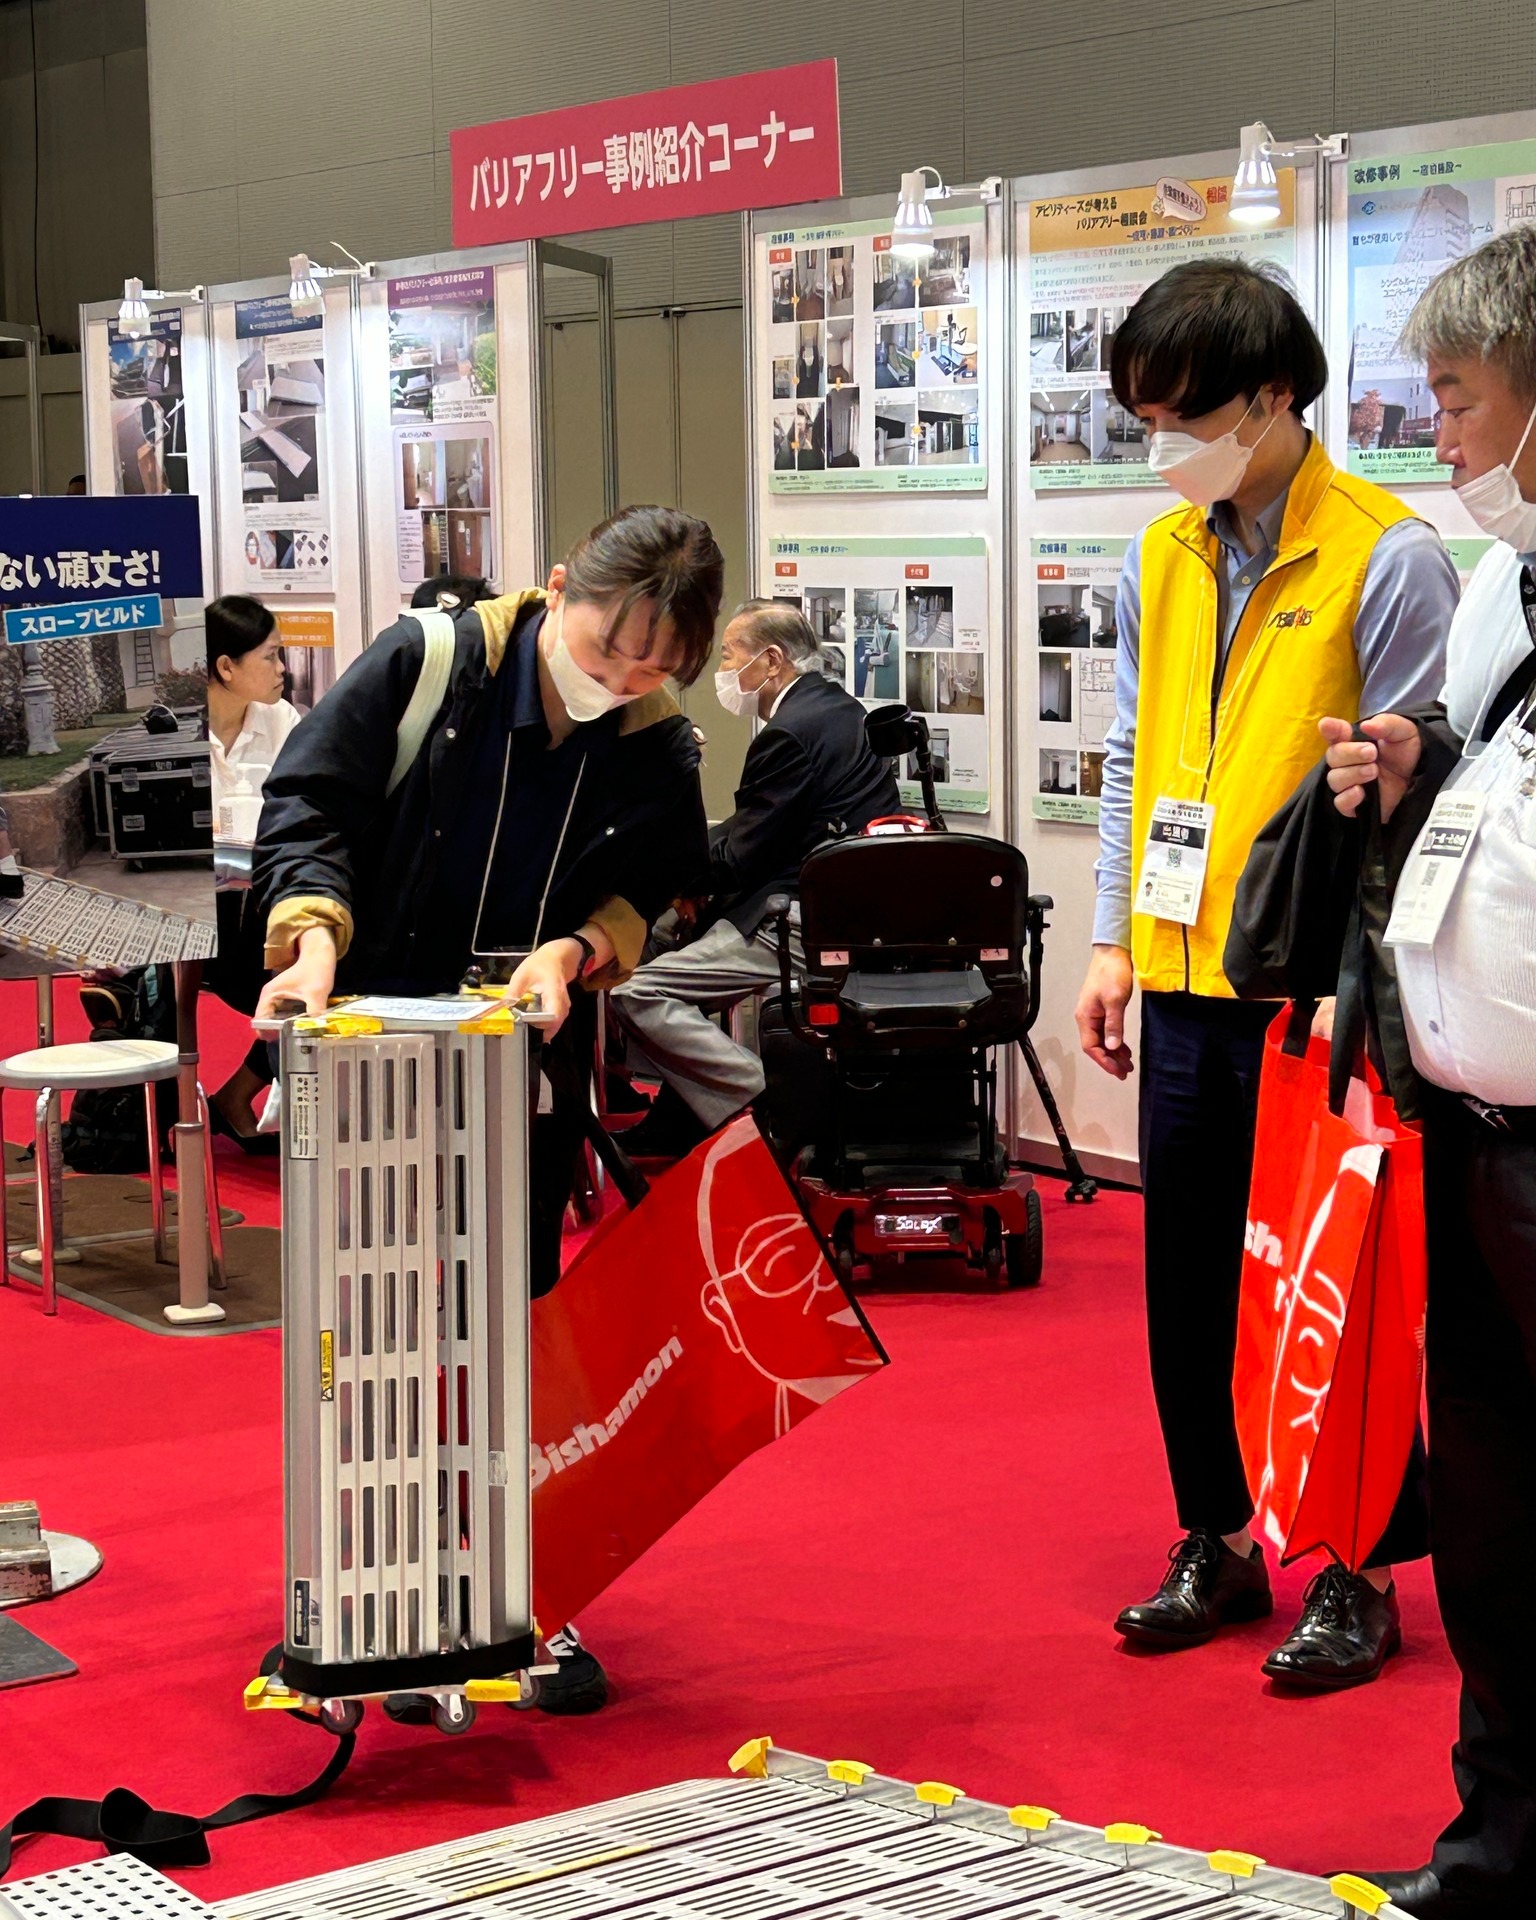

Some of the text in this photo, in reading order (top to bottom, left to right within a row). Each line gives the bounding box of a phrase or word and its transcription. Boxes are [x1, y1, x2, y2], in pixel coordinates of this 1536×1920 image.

[470, 110, 815, 211] バリアフリー事例紹介コーナー
[20, 604, 146, 637] スロープビルド
